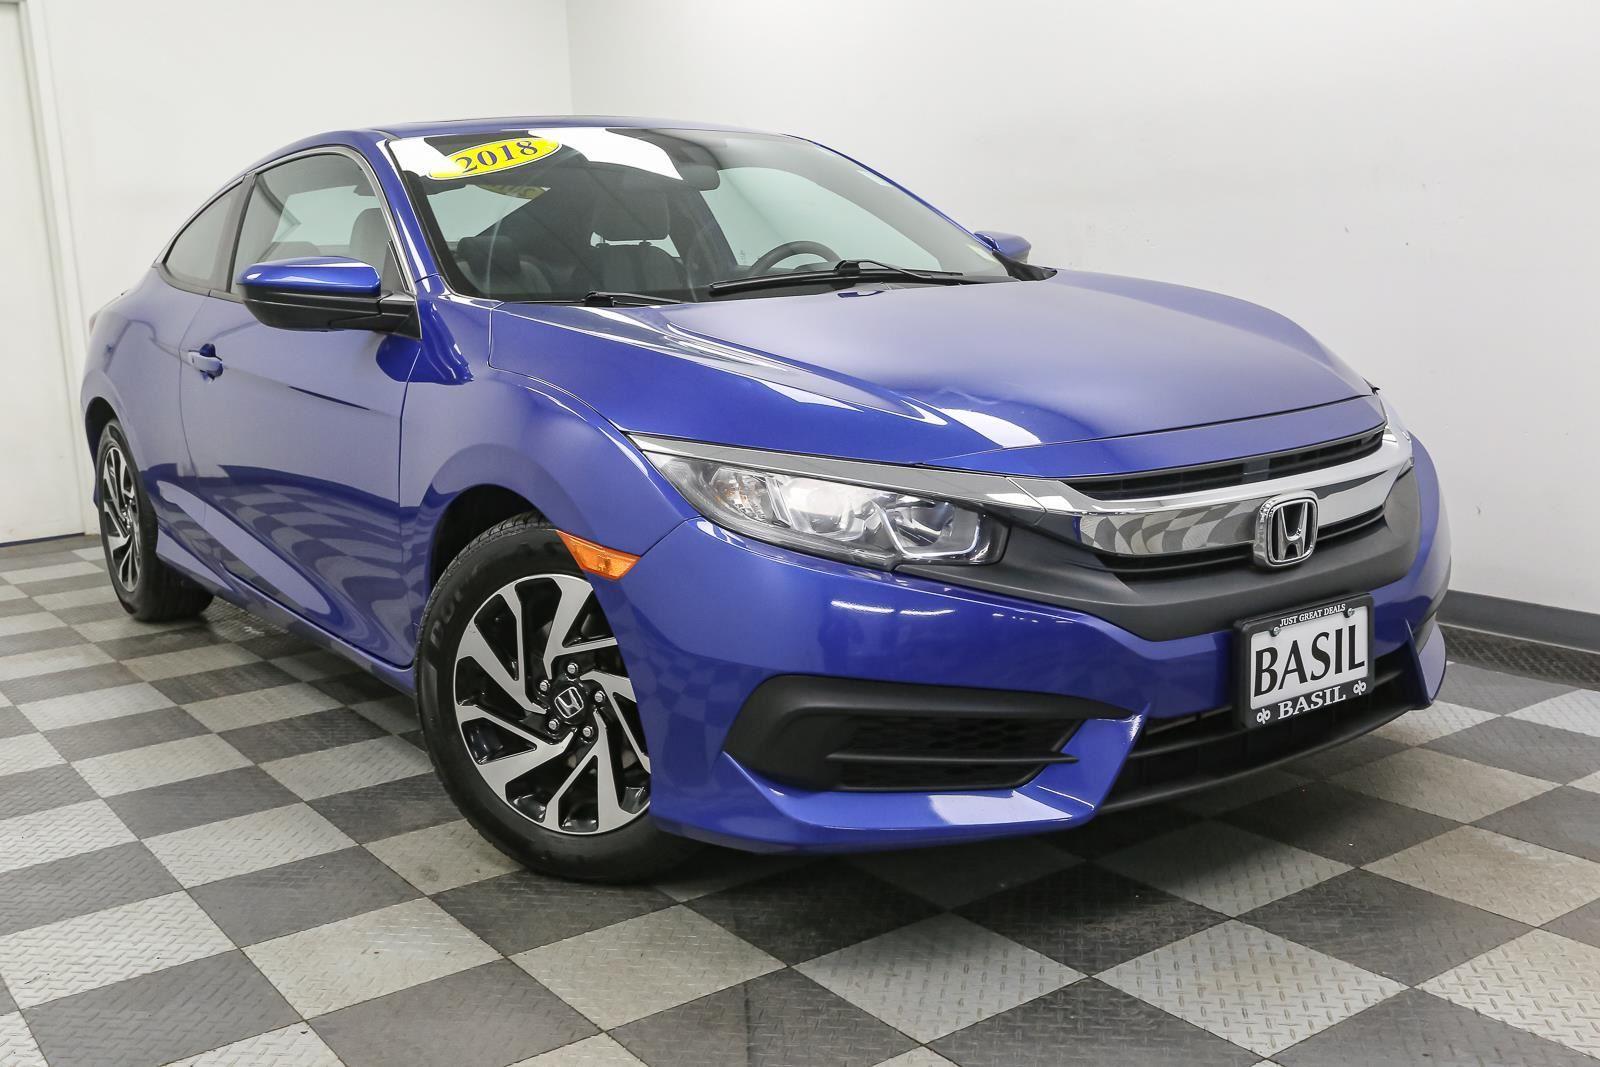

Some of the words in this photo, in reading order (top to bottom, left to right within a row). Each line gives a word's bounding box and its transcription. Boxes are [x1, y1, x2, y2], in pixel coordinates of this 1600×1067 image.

[455, 140, 538, 173] 2018
[1279, 616, 1298, 627] JUST
[1299, 609, 1323, 622] GREAT
[1323, 603, 1346, 616] DEALS
[1254, 624, 1365, 697] BASIL
[1278, 686, 1346, 720] BASIL
